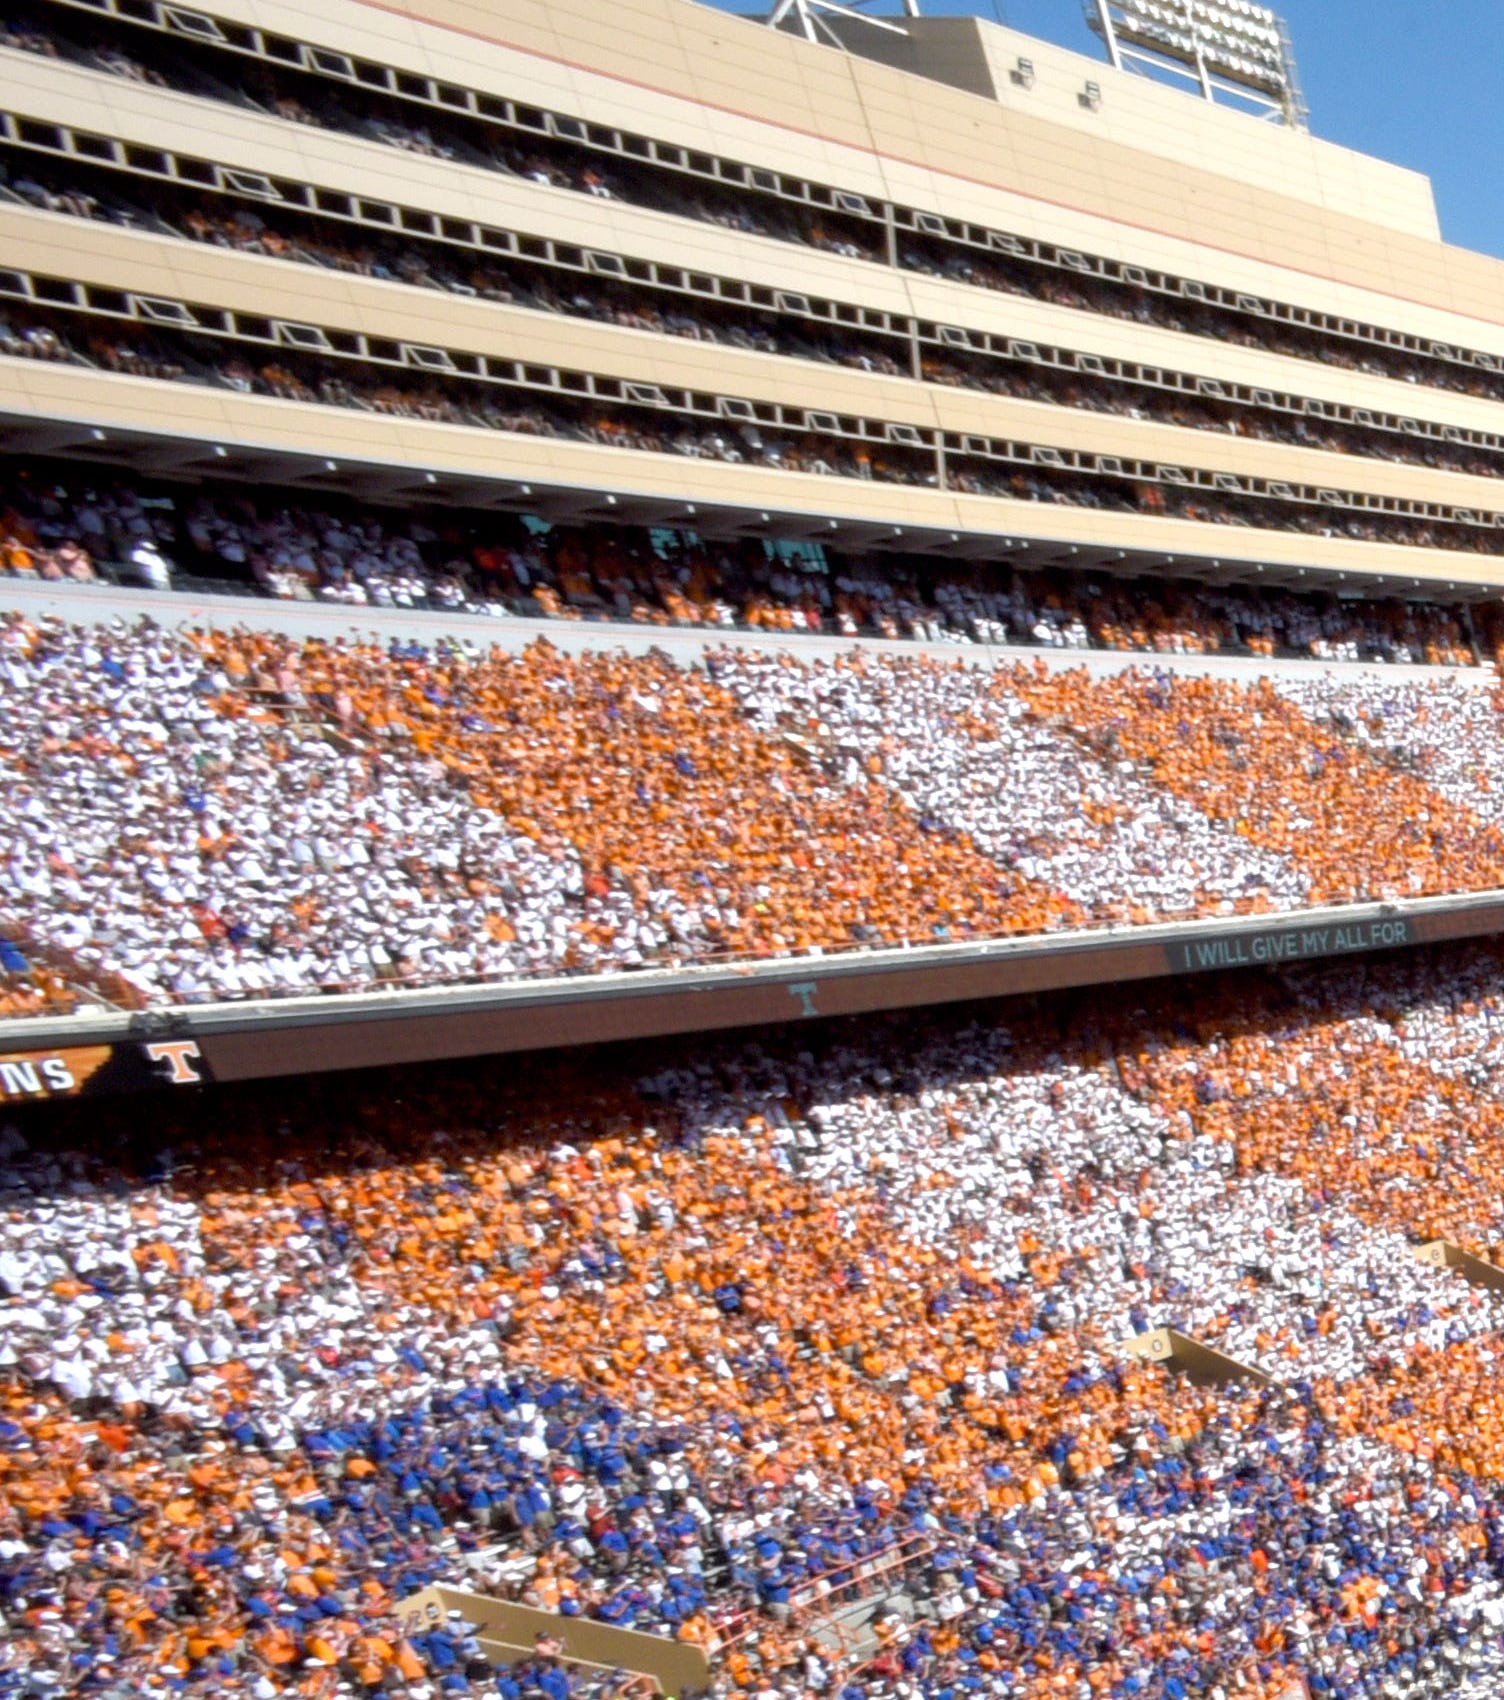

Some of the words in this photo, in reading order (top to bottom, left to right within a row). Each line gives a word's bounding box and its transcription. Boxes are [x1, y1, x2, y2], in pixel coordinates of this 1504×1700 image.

[1184, 945, 1192, 967] I
[1197, 941, 1249, 967] WILL
[1251, 933, 1297, 960] GIVE
[1301, 930, 1330, 953] MY
[1334, 926, 1367, 949] ALL
[1371, 921, 1407, 945] FOR
